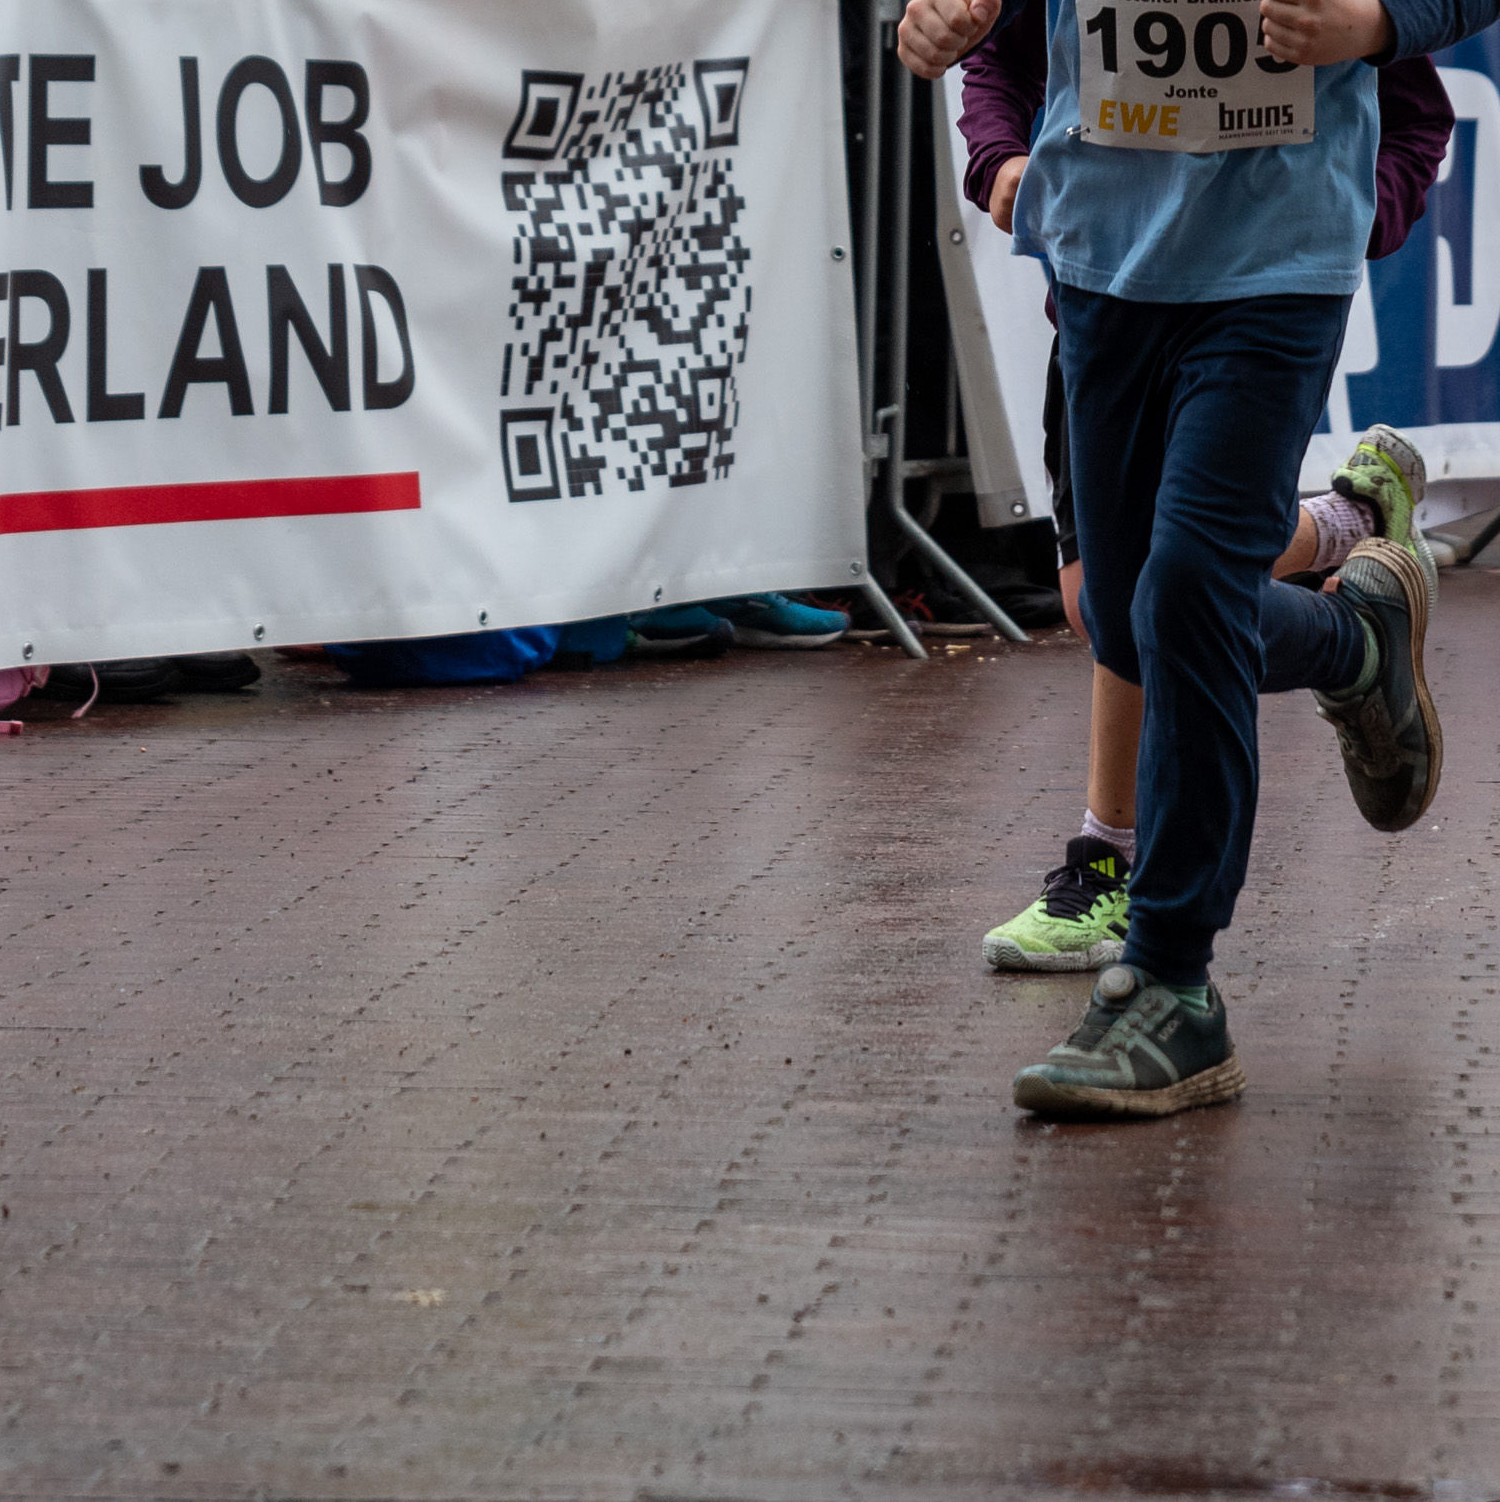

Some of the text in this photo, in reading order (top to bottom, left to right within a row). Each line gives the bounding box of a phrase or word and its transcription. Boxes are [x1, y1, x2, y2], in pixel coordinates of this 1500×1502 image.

[1164, 84, 1218, 98] Jonte
[139, 54, 372, 211] JOB
[1098, 98, 1181, 136] EWE
[1219, 102, 1293, 131] bruns
